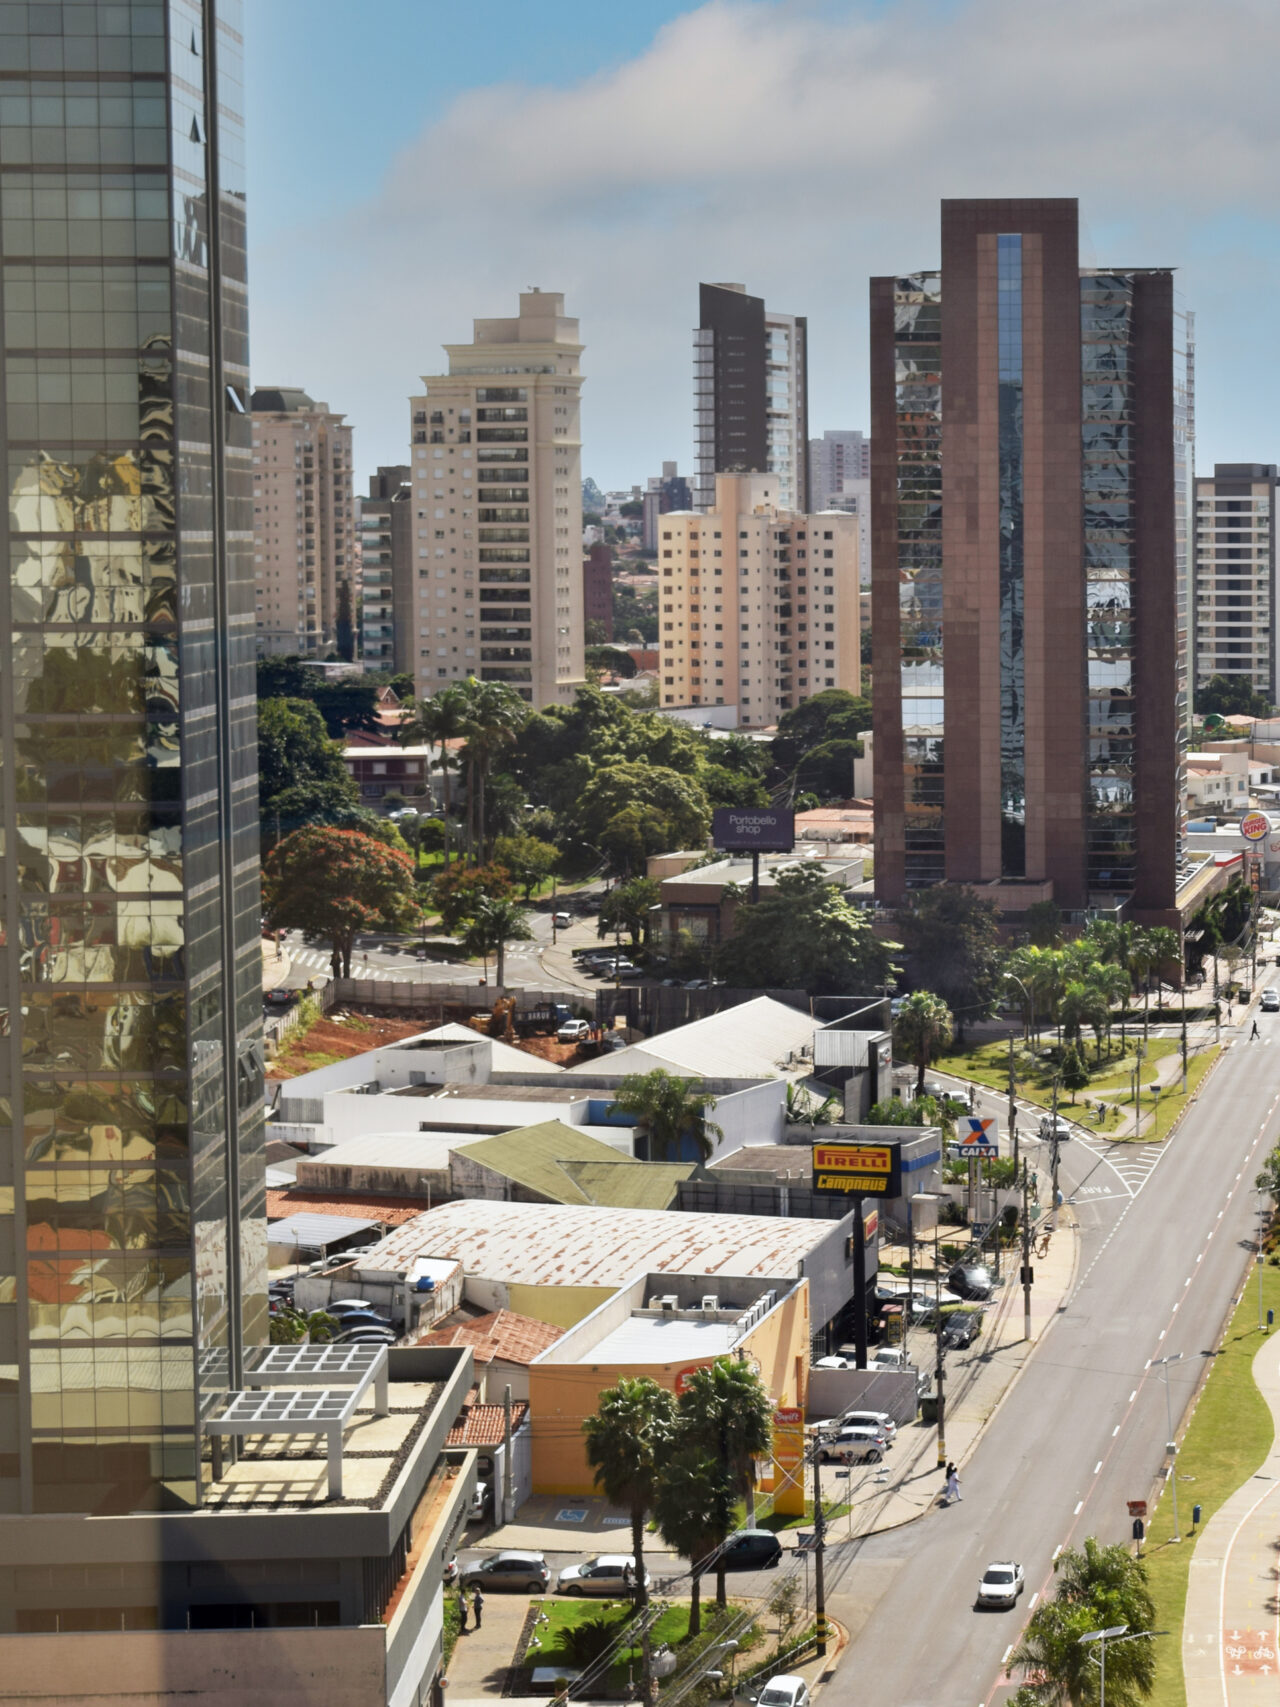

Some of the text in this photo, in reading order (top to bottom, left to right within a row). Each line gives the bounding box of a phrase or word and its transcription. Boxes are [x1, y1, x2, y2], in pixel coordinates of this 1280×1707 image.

[736, 824, 761, 836] shop
[1244, 823, 1267, 836] KING
[960, 1147, 997, 1157] CAIXA
[816, 1149, 888, 1169] PIRELLI
[816, 1174, 889, 1194] Campneus
[775, 1411, 800, 1421] Swift
